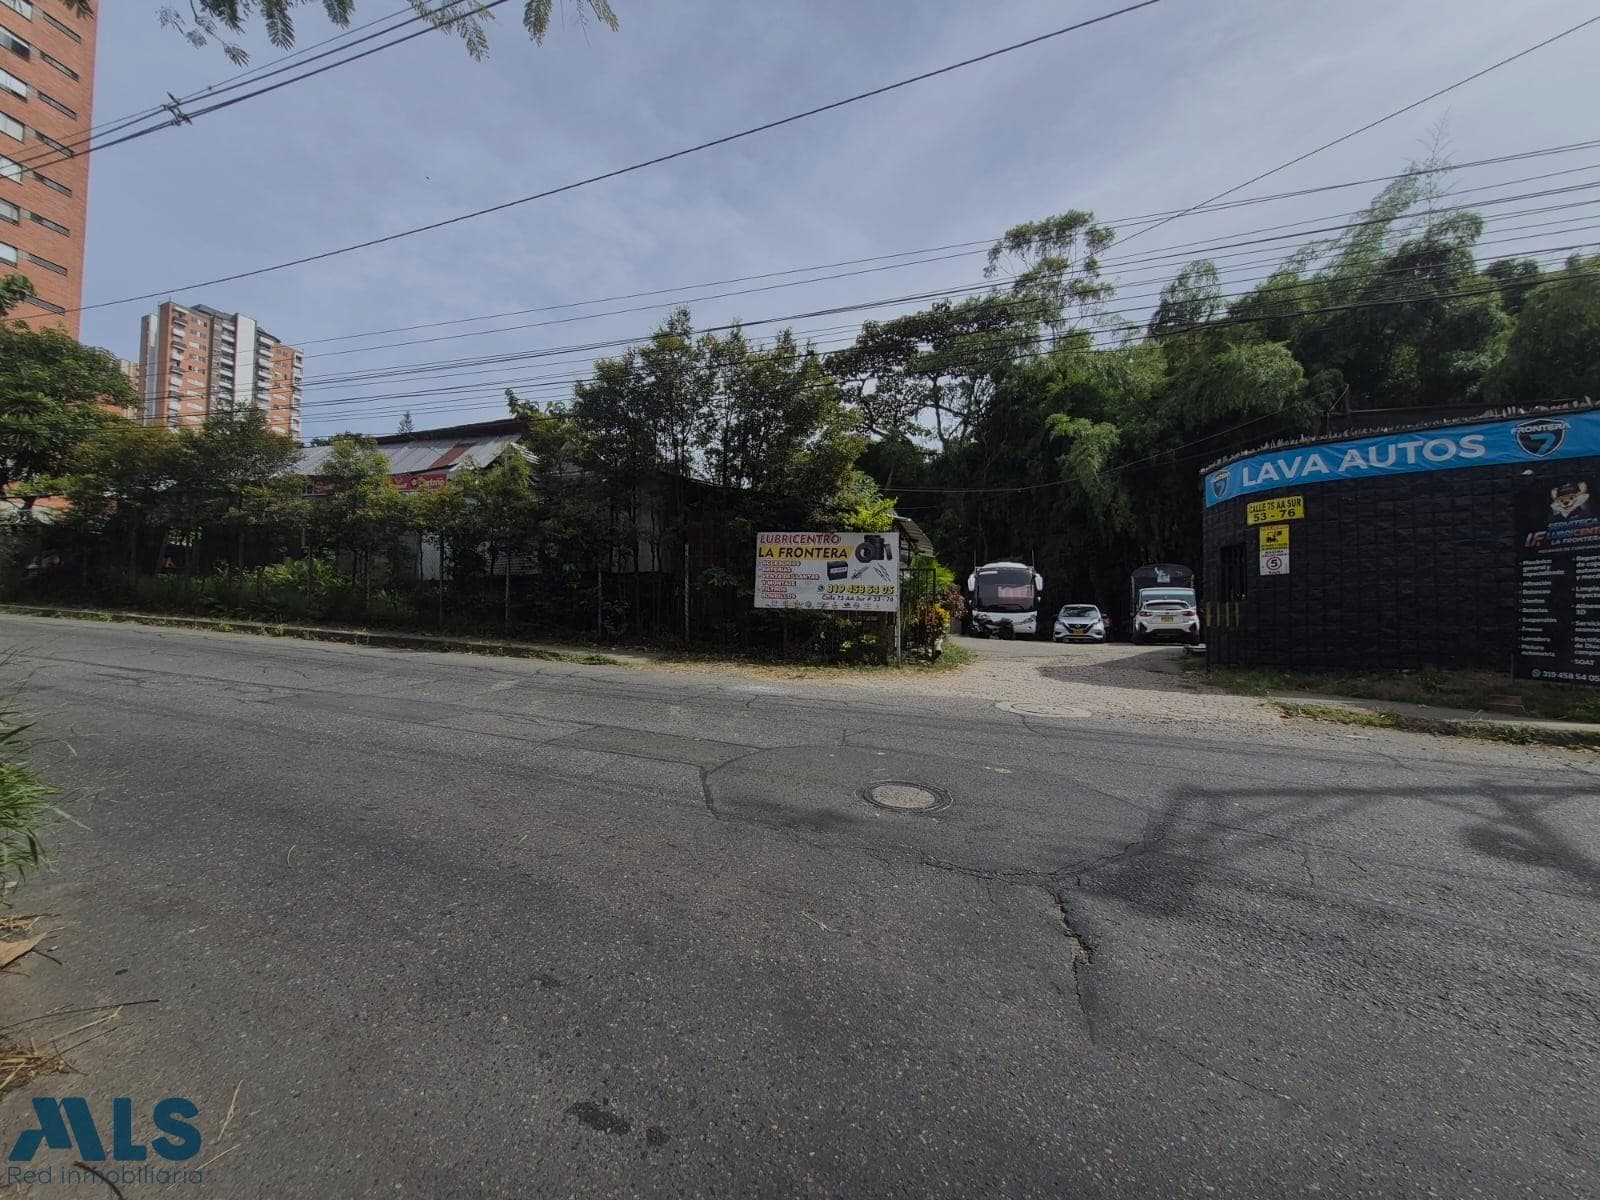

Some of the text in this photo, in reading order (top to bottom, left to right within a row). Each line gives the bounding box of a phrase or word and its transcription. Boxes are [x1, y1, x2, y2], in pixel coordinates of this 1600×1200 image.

[1510, 422, 1571, 434] FRONTERA
[1243, 434, 1487, 487] LAVA AUTOS
[1250, 498, 1301, 513] CALLE 75 AA SUR
[1253, 512, 1267, 522] 53
[1279, 508, 1296, 518] 76
[760, 534, 841, 544] LUBRICENTRO
[758, 547, 848, 558] LA FRONTERA
[1270, 558, 1278, 568] 5
[826, 584, 894, 594] 319 458 54 05
[1542, 670, 1556, 678] 319
[1557, 671, 1574, 680] 458
[1575, 673, 1587, 681] 54
